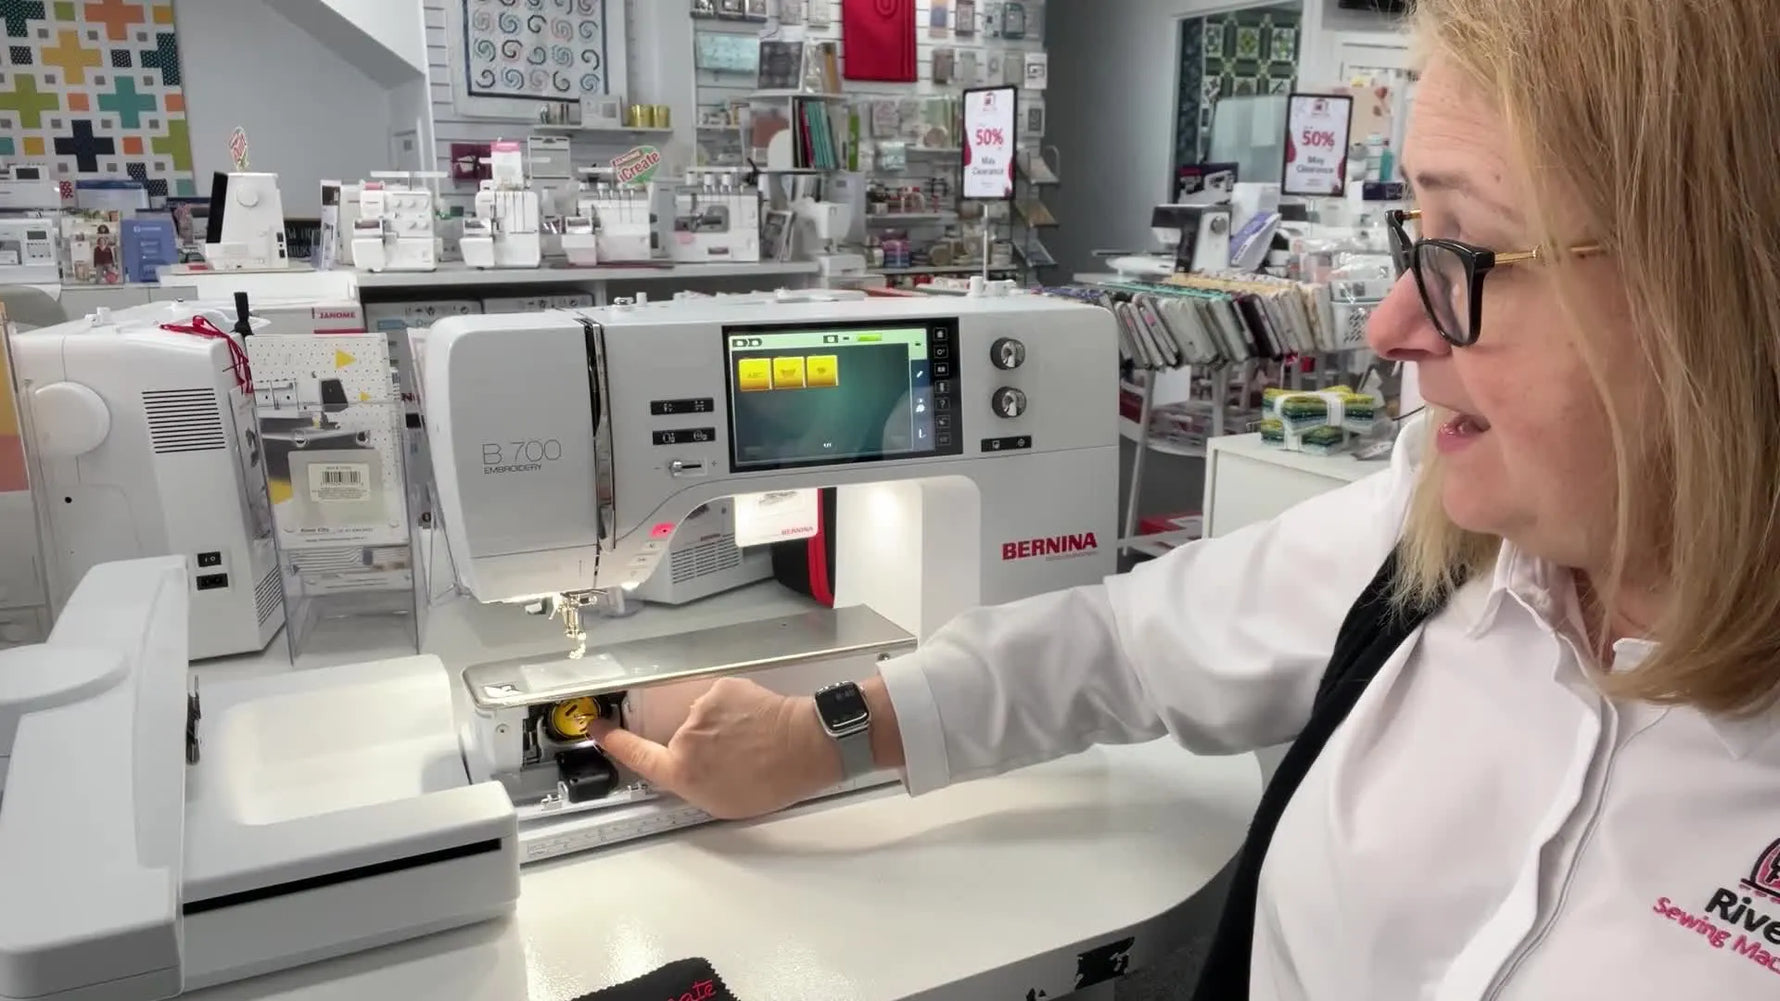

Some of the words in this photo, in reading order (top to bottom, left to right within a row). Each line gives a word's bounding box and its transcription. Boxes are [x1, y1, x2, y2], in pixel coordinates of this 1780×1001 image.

[976, 128, 1004, 146] 50%
[1302, 130, 1335, 147] 50%
[619, 152, 660, 182] iCreate
[319, 311, 356, 319] JANOME
[482, 443, 503, 465] B
[510, 439, 562, 464] 700
[483, 464, 542, 475] EMBROIDERY
[781, 525, 814, 536] BERNINA
[1002, 532, 1098, 560] BERNINA
[1653, 896, 1731, 948] Sewing
